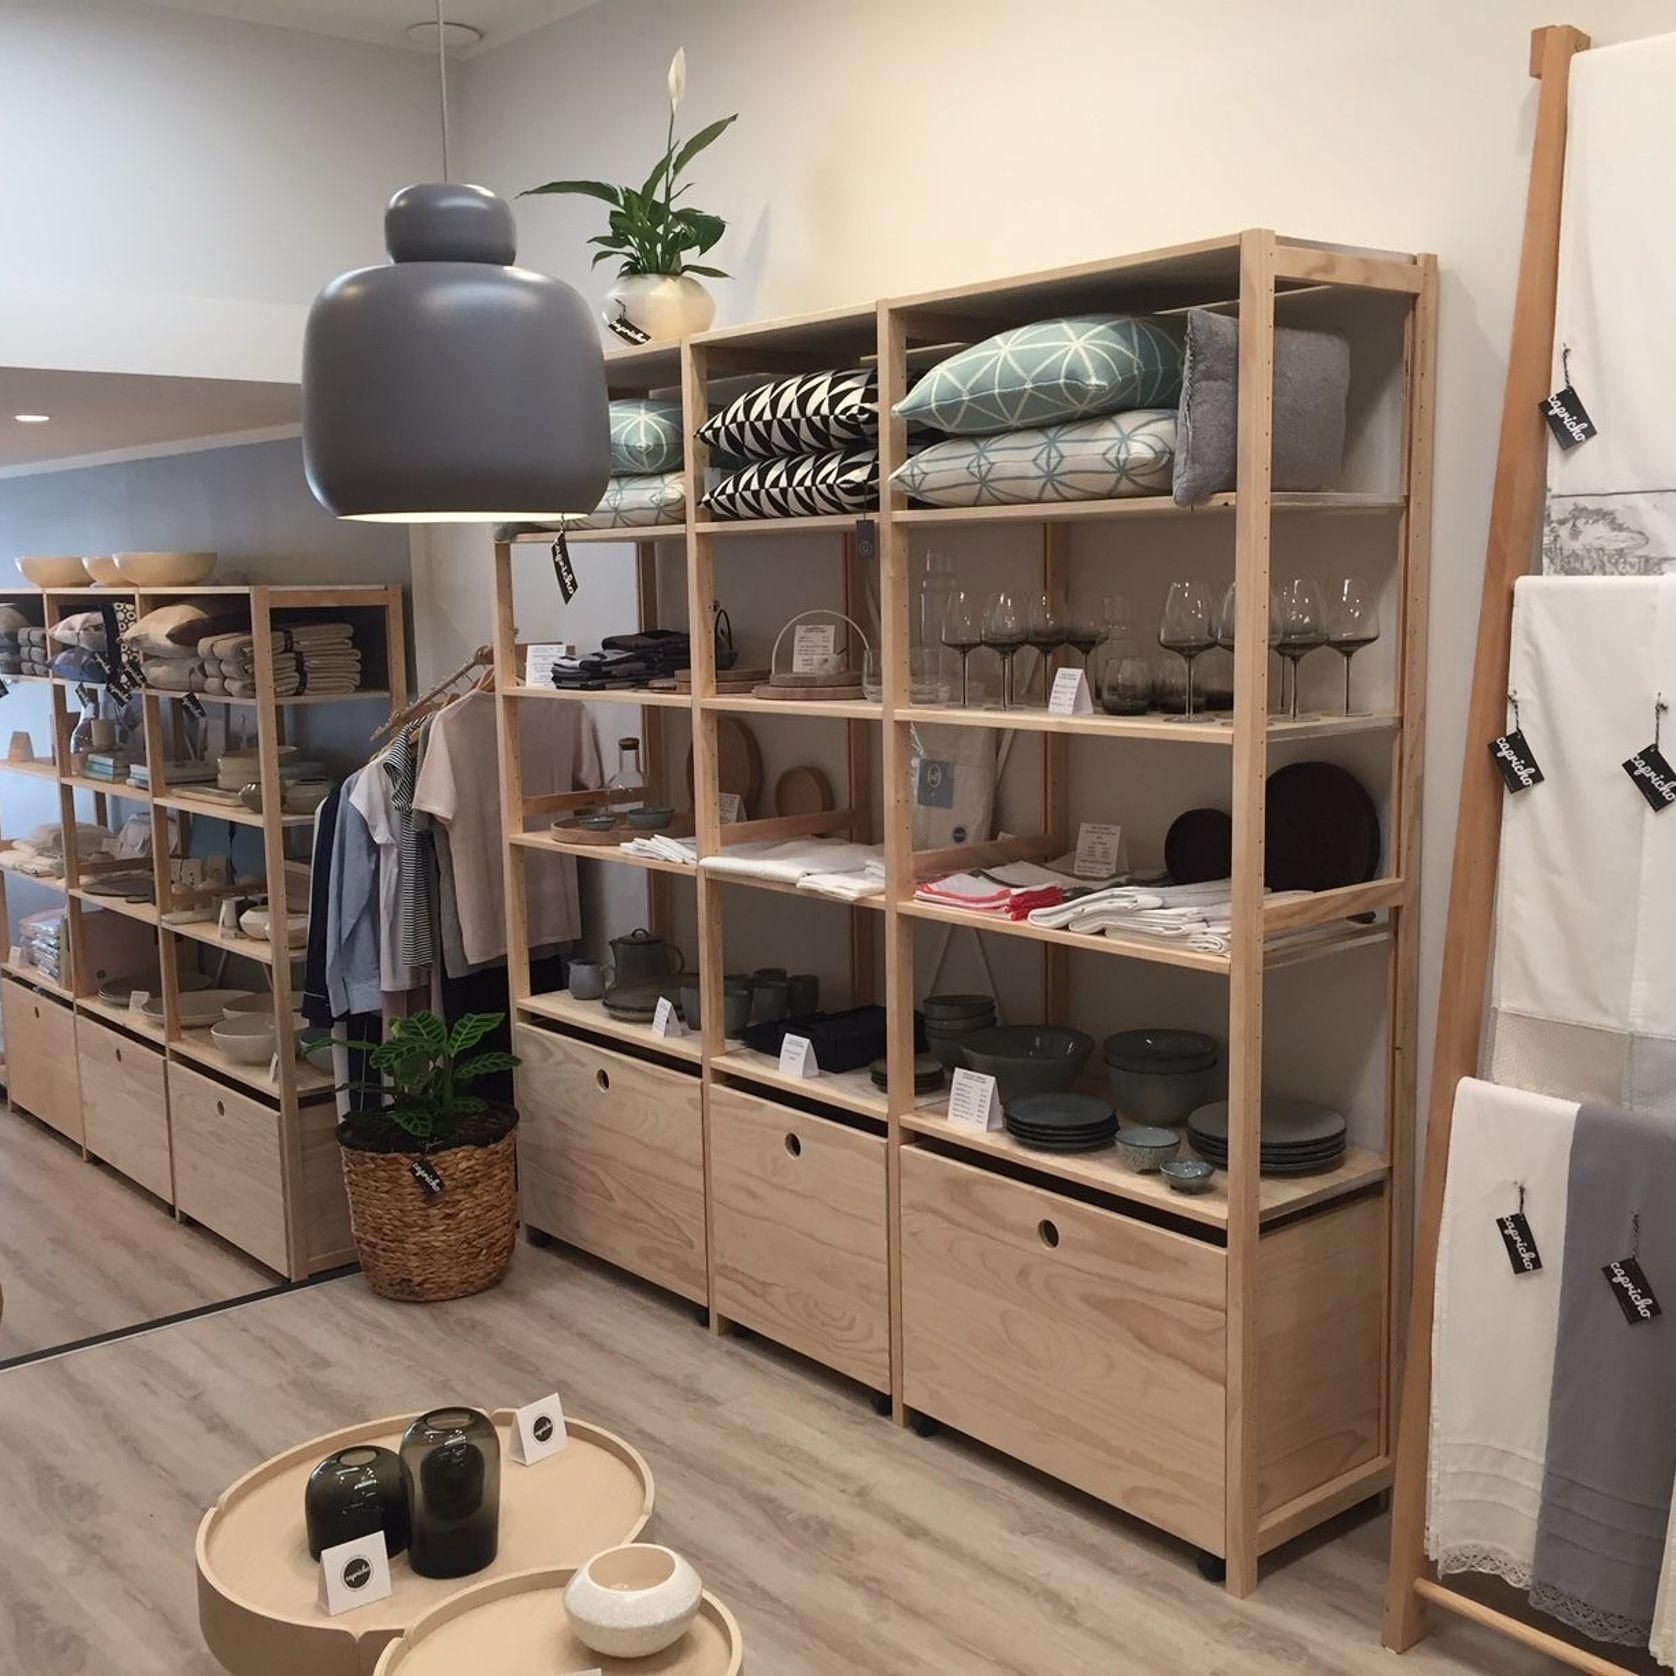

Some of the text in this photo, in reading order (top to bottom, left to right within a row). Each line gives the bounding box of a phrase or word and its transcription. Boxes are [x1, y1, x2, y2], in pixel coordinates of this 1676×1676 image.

[1547, 395, 1588, 443] capricho
[1496, 736, 1537, 788] capricho
[1630, 754, 1676, 802] capricho
[1503, 1216, 1536, 1272] capricho
[1610, 1261, 1653, 1320] capricho
